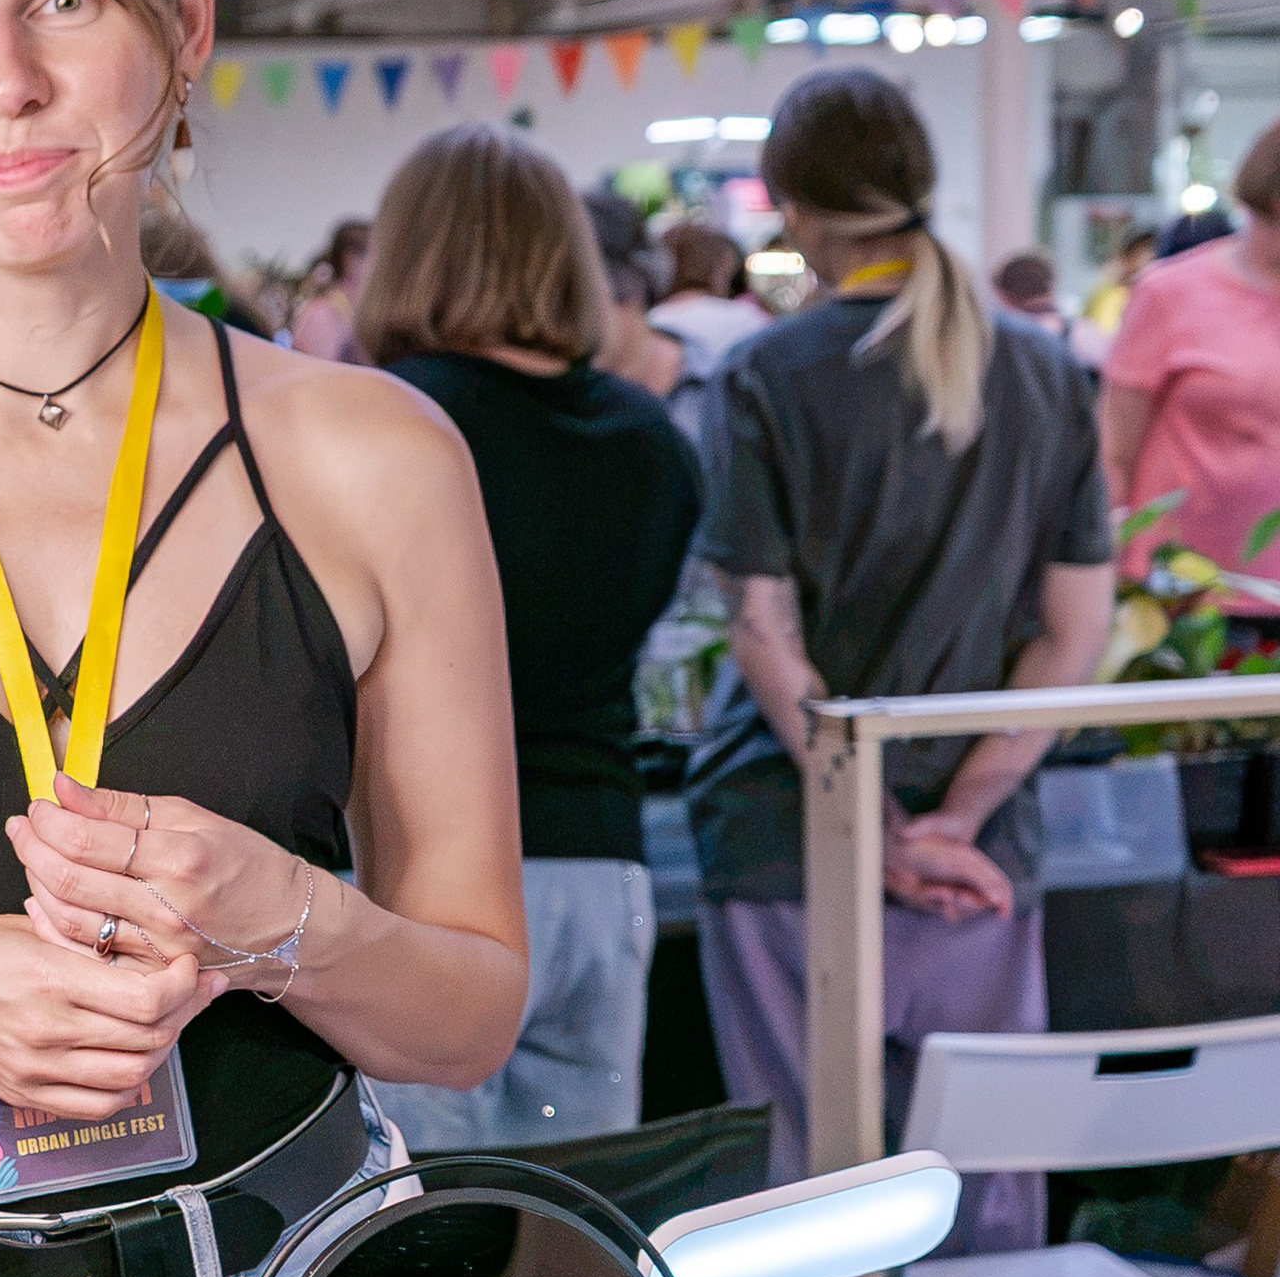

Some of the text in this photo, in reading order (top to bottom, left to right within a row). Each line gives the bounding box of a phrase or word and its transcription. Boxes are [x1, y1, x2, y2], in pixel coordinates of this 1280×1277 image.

[16, 1113, 166, 1156] URBAN JUNGLE FEST
